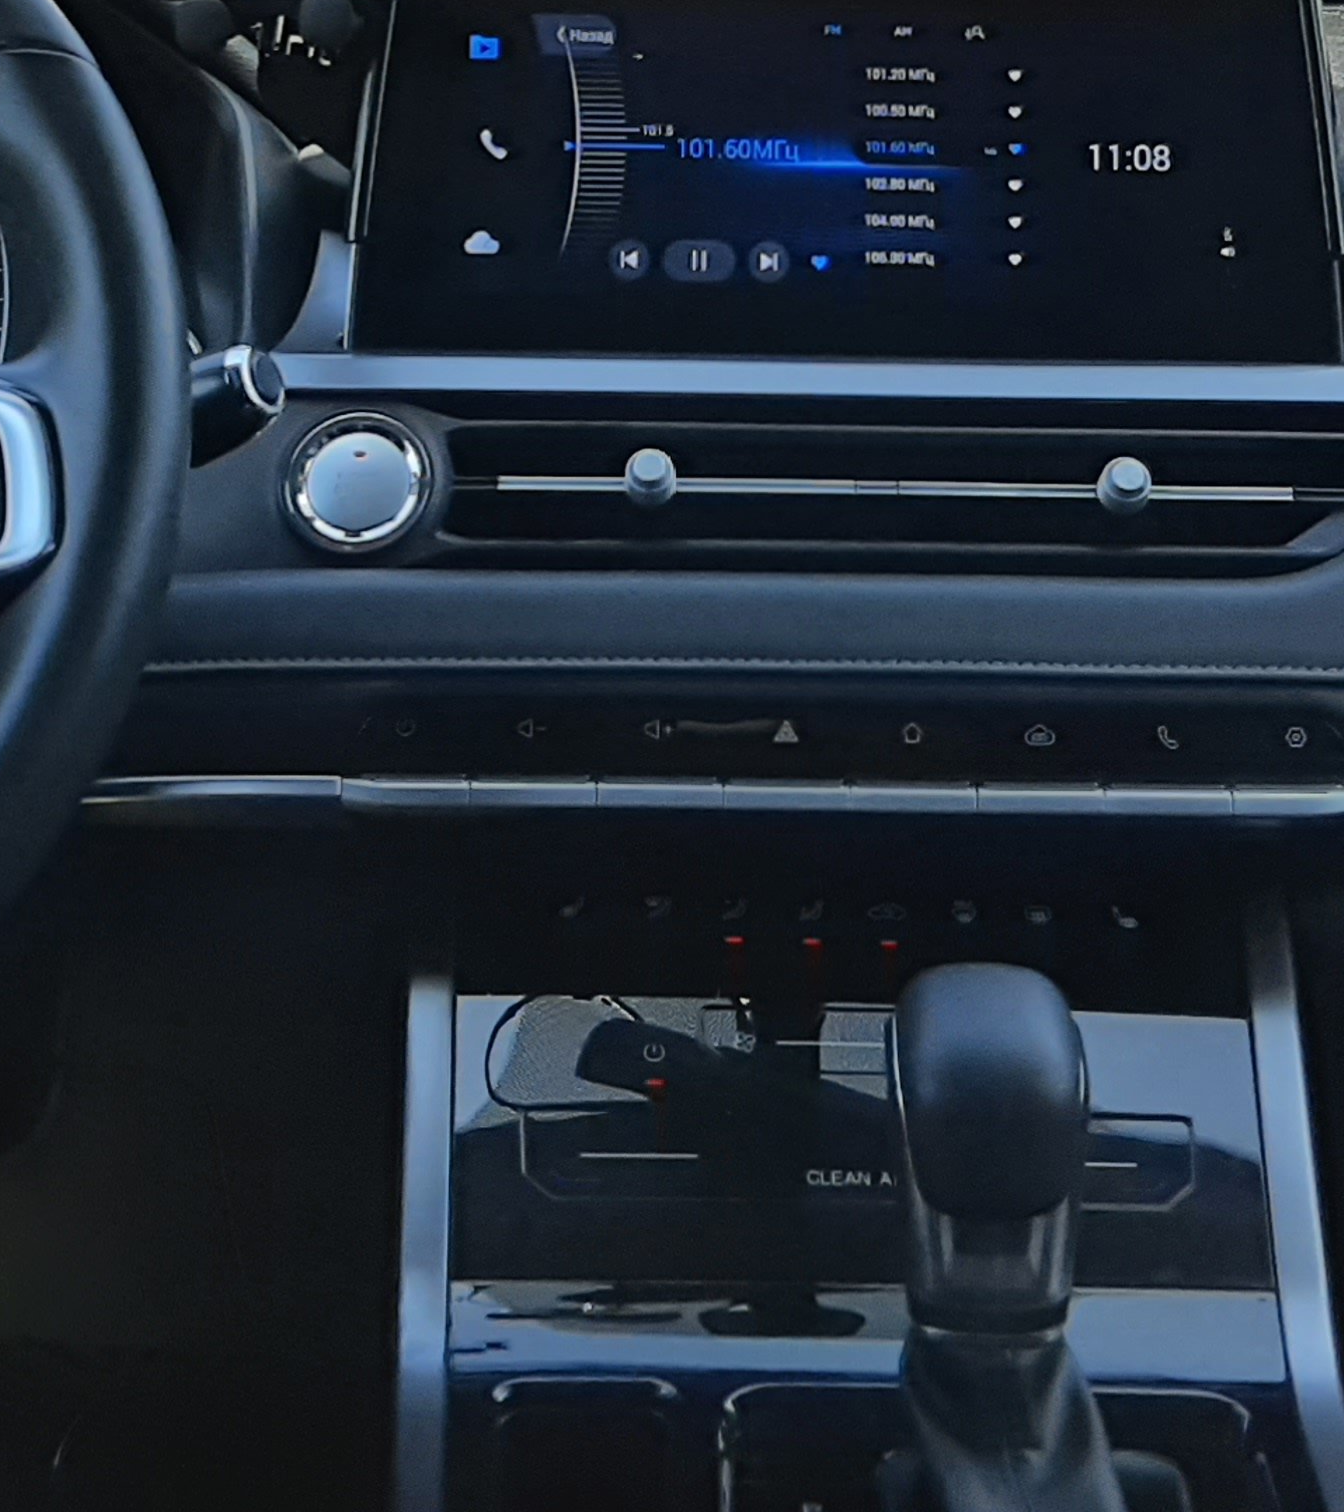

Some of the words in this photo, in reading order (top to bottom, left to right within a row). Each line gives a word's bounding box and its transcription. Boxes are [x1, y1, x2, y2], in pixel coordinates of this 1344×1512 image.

[893, 25, 913, 38] AM
[1088, 142, 1172, 173] 11:08
[806, 1169, 871, 1186] CLEAN
